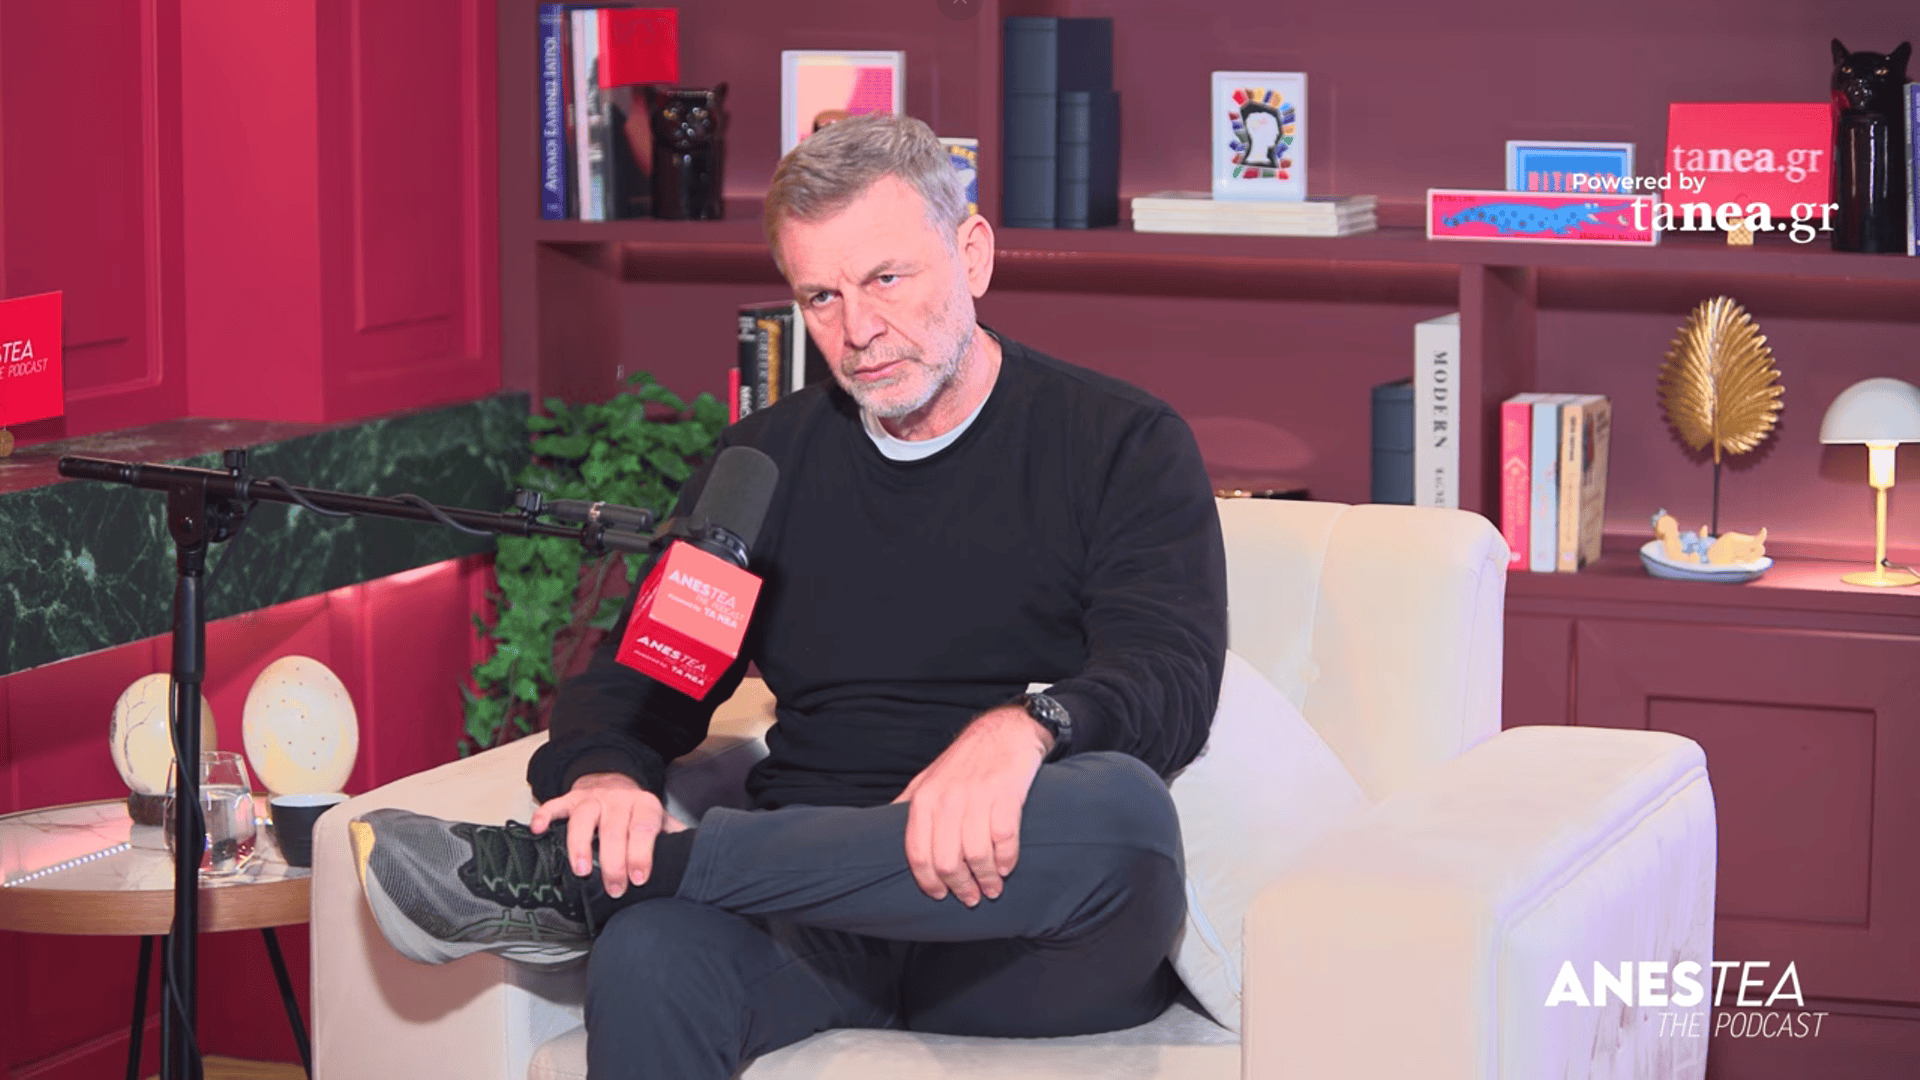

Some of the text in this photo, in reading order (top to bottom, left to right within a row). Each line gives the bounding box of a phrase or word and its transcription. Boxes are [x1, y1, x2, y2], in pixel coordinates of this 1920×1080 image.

[1673, 145, 1823, 183] tanea.gr
[0, 338, 33, 364] TEA
[8, 357, 48, 378] PODCAST
[1433, 351, 1449, 447] MODERN
[668, 569, 736, 609] ANESTEA
[636, 635, 707, 673] ANESTEA
